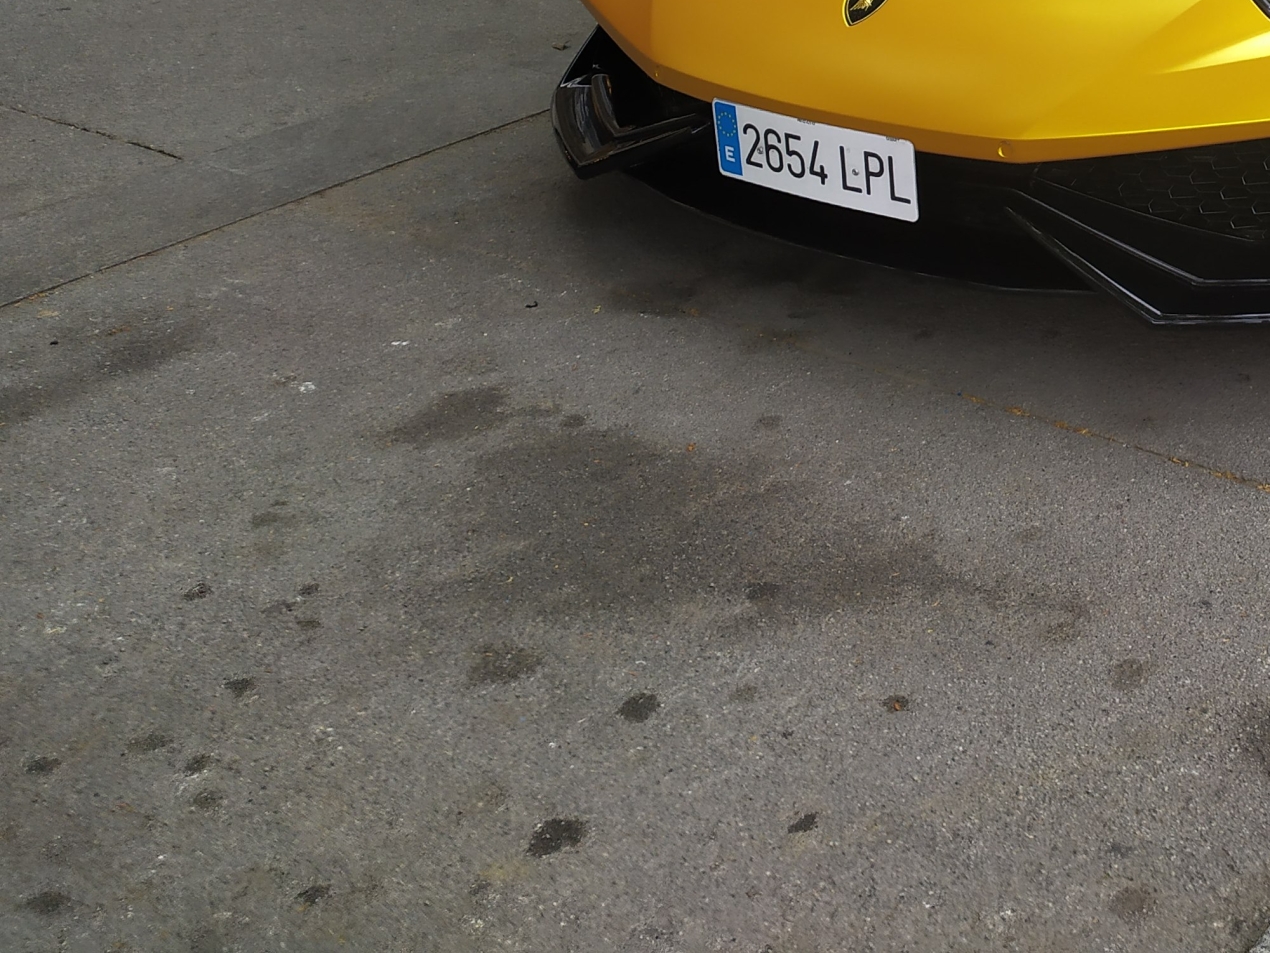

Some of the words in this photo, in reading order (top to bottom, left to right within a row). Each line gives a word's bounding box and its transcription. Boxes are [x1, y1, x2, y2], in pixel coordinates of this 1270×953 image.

[725, 146, 736, 163] E
[743, 123, 828, 185] 2654
[839, 145, 911, 204] LPL
